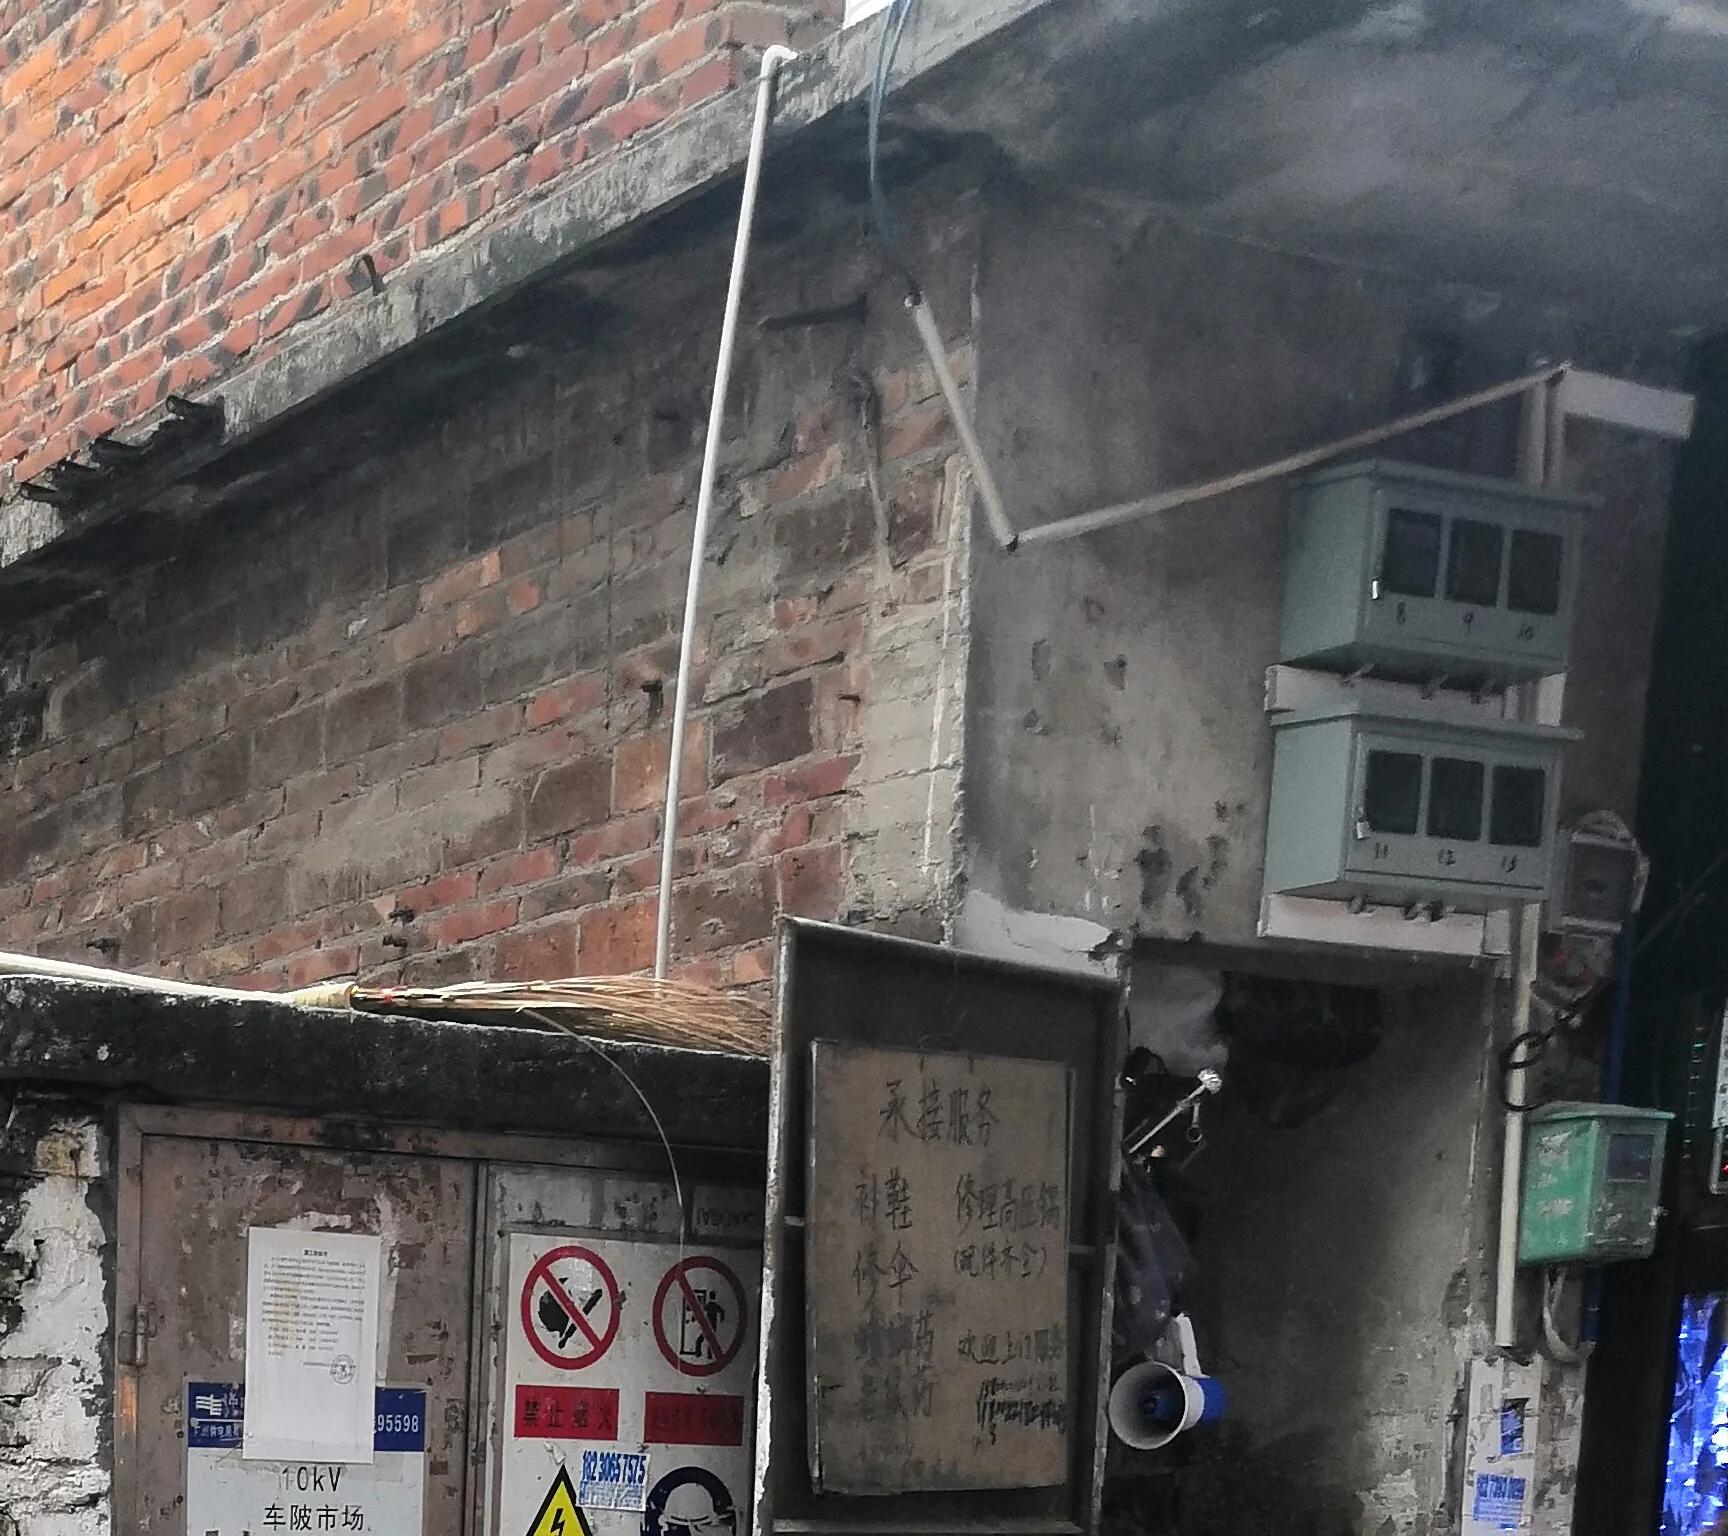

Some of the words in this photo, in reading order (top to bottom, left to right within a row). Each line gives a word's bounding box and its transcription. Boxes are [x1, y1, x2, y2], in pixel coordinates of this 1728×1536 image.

[876, 1079, 1000, 1147] 承接服务
[376, 1413, 420, 1433] 95598
[281, 1465, 342, 1492] 10kV
[263, 1503, 365, 1532] 车陂市场
